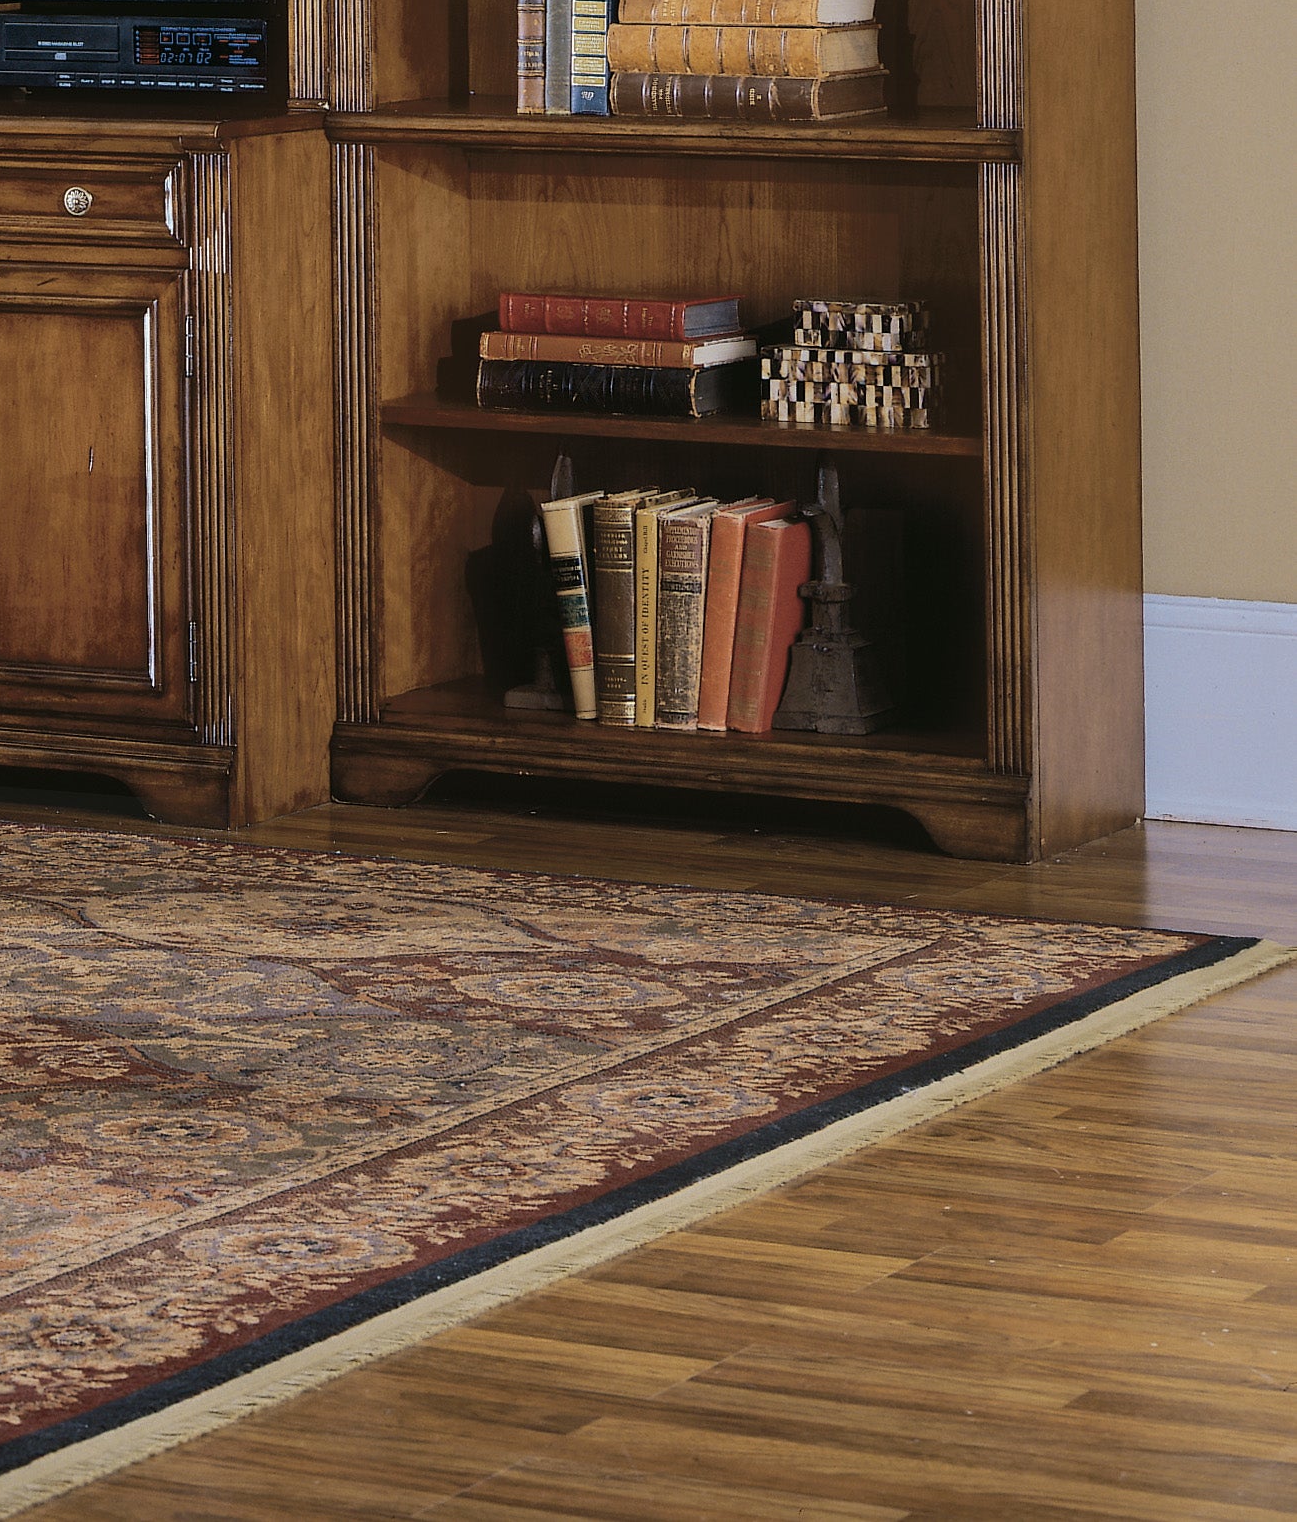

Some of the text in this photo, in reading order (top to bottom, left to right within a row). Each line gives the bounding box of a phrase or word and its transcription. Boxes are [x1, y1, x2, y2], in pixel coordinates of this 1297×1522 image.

[196, 52, 212, 64] 02
[642, 567, 650, 618] IDENTITY
[642, 621, 649, 636] OF
[641, 674, 649, 685] IN
